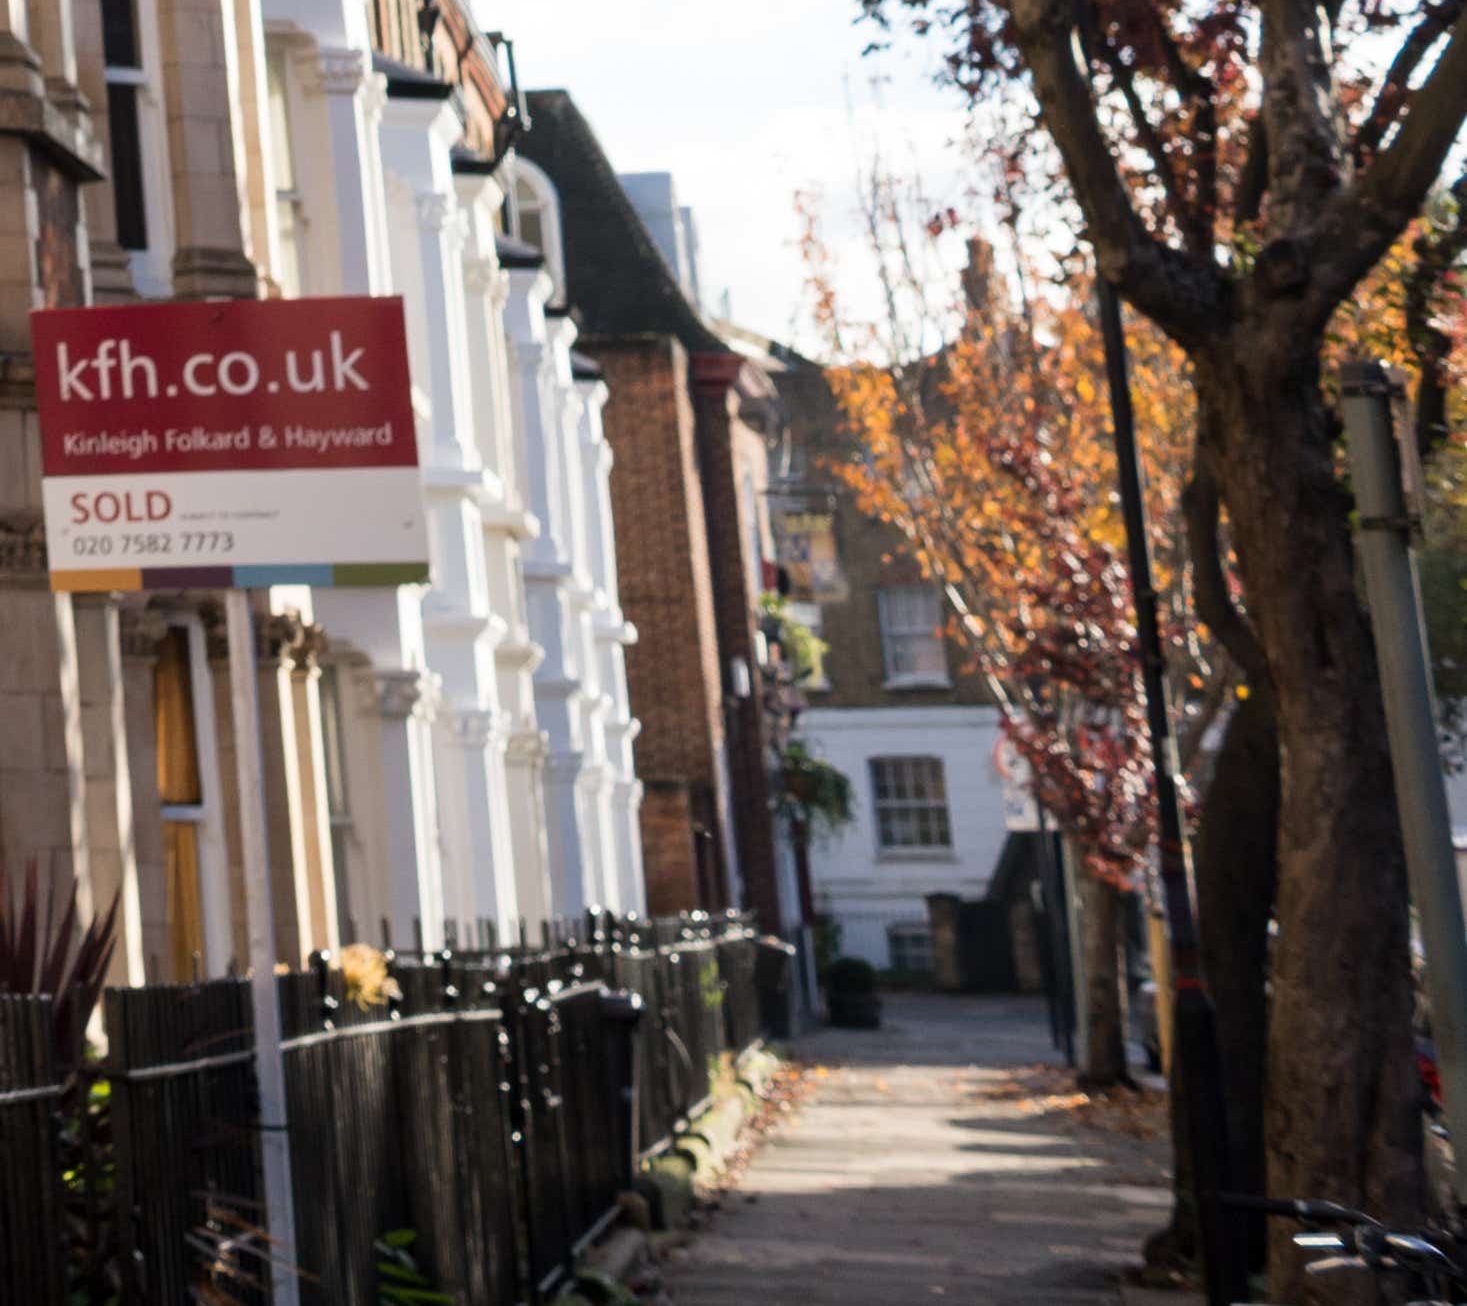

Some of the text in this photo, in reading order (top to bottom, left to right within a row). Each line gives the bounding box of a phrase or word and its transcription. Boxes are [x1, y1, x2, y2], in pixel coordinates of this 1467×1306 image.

[57, 331, 369, 401] kfh.co.uk
[64, 421, 393, 459] Kinleigh Folkard & Hayward
[71, 490, 173, 524] SOLD
[73, 530, 234, 555] 020 7582 7773
